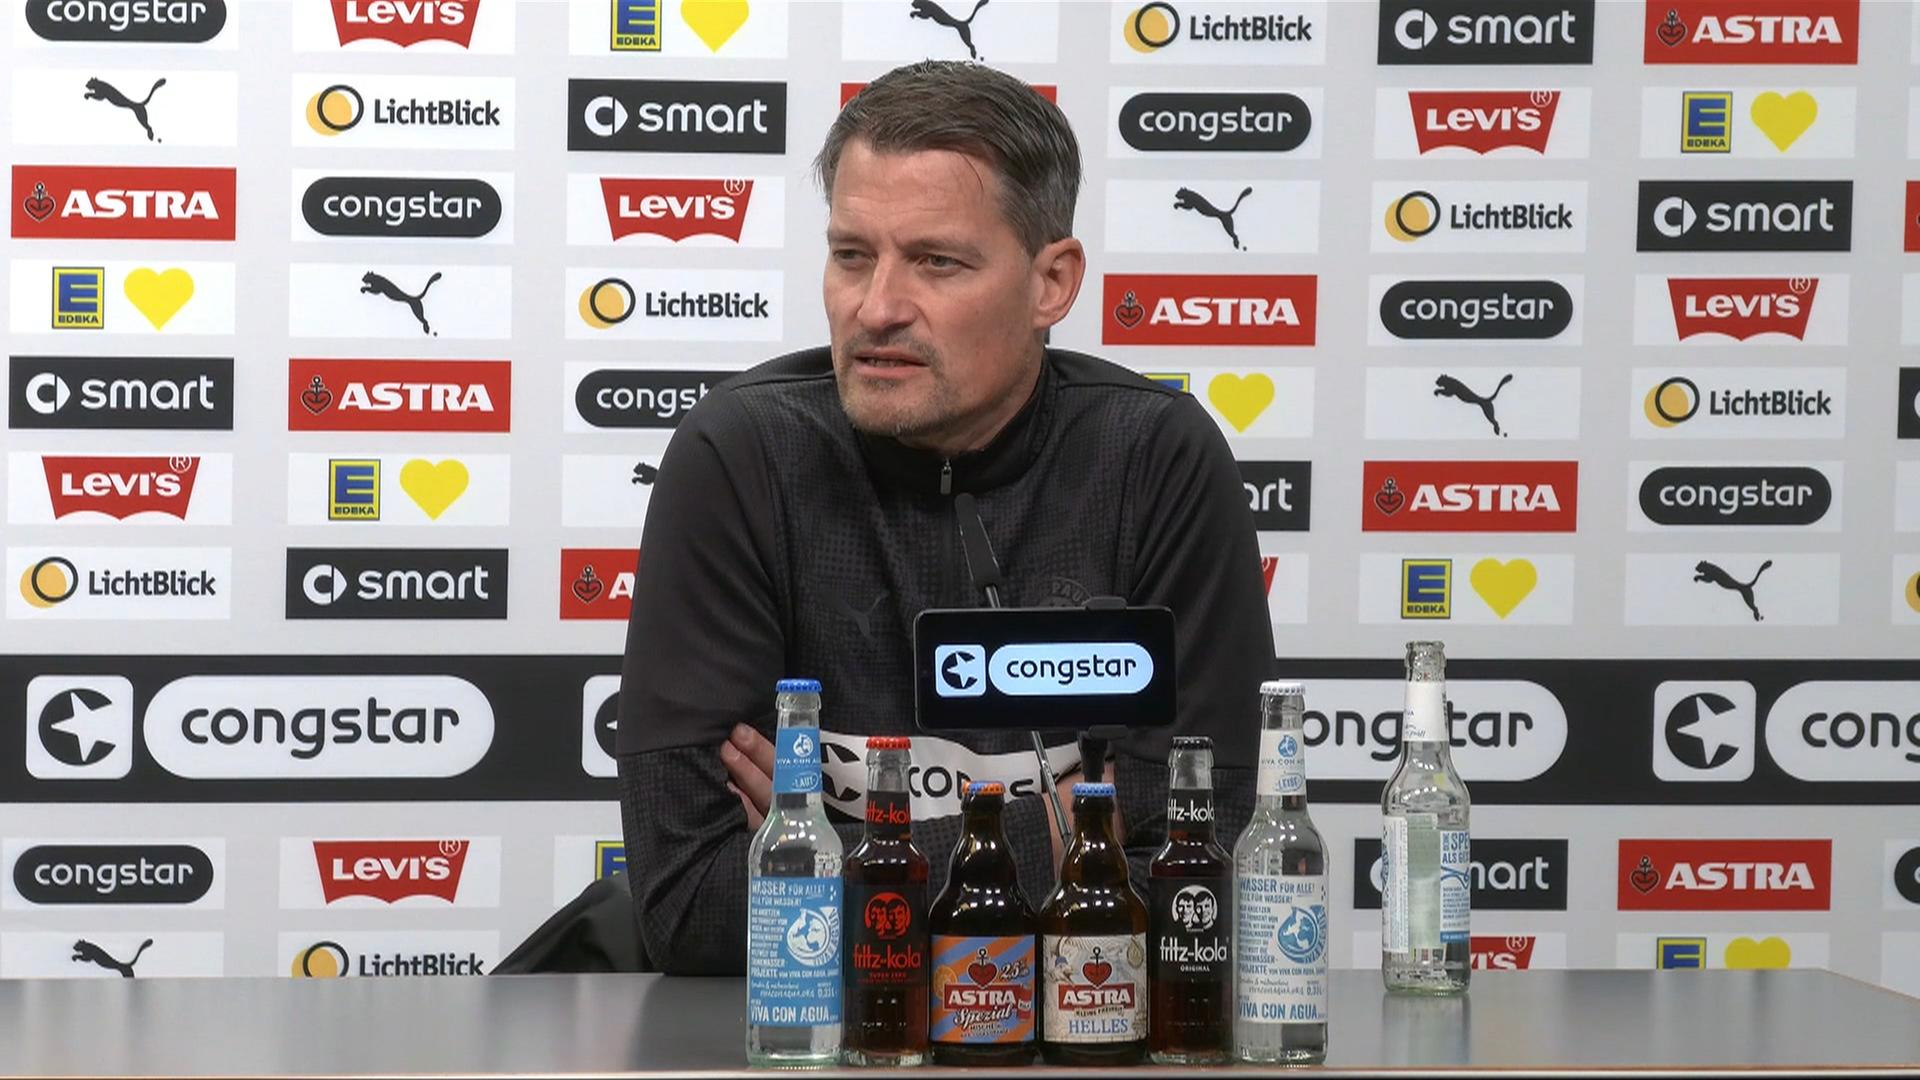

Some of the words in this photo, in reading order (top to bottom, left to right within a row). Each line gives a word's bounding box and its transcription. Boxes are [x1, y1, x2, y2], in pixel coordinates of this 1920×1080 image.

[46, 0, 207, 31] congstar
[1189, 14, 1312, 42] LichtBlick
[1447, 10, 1576, 44] smart
[1692, 15, 1842, 44] ASTRA
[616, 36, 656, 46] EDEKA
[374, 98, 500, 126] LichtBlick
[637, 99, 768, 134] smart
[1138, 105, 1293, 142] congstar
[1686, 137, 1727, 148] EDEKA
[60, 189, 219, 220] ASTRA
[323, 190, 482, 226] congstar
[1450, 203, 1573, 230] LichtBlick
[1706, 198, 1834, 233] smart
[57, 314, 99, 324] EDEKA
[645, 291, 769, 319] LichtBlick
[1149, 297, 1300, 326] ASTRA
[1400, 292, 1554, 329] congstar
[80, 375, 214, 410] smart
[337, 382, 494, 412] ASTRA
[596, 383, 709, 418] congs
[1709, 389, 1832, 416] LichtBlick
[1243, 477, 1293, 512] art
[1409, 484, 1561, 512] ASTRA
[1659, 479, 1813, 515] congstar
[333, 506, 375, 516] EDEKA
[88, 569, 216, 597] LichtBlick
[357, 565, 489, 600] smart
[1406, 604, 1446, 614] EDEKA
[1006, 654, 1137, 686] congstar
[181, 696, 460, 760] congstar
[1302, 701, 1534, 762] ongtar
[34, 857, 194, 894] congstar
[1240, 878, 1277, 893] WASSER
[1470, 856, 1550, 891] art
[1665, 862, 1815, 890] ASTRA
[854, 944, 922, 969] fritz-kola
[1159, 936, 1228, 962] fritz-kola
[359, 953, 484, 977] LichtBlick
[947, 989, 1017, 1006] ASTRA
[1062, 988, 1132, 1006] ASTRA
[1239, 1001, 1259, 1019] VIVA
[1261, 1003, 1286, 1019] CON
[1289, 1003, 1318, 1020] AGUA
[751, 1005, 770, 1022] VIVA
[772, 1006, 797, 1023] CON
[800, 1006, 830, 1023] AGUA
[1068, 1019, 1129, 1035] HELLES
